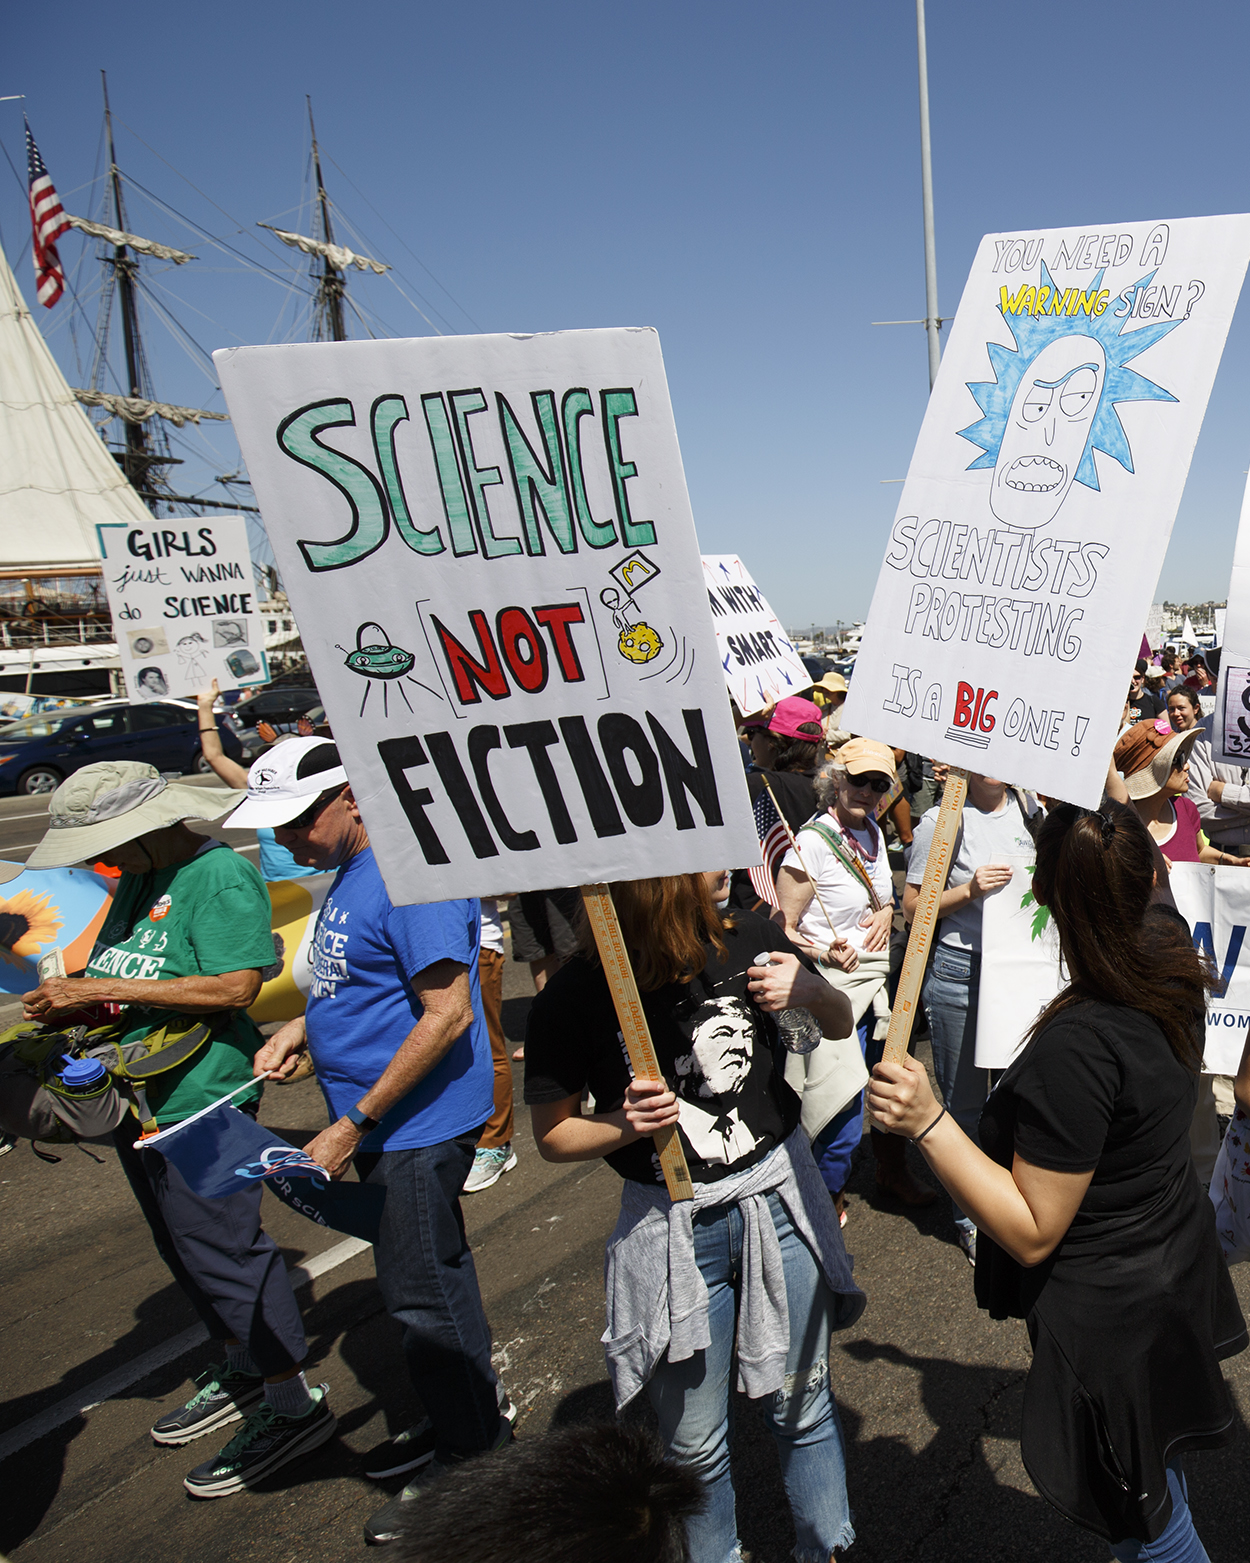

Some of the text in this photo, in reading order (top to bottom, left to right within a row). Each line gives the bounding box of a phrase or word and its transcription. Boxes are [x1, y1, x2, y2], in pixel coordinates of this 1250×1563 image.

[992, 224, 1170, 273] YOU NEED A
[999, 284, 1110, 316] WARNING
[276, 387, 658, 572] SCIENCE
[127, 528, 217, 561] GIRLS
[886, 516, 1110, 598] SCIENTISTS
[112, 562, 245, 593] just WANNA
[118, 593, 253, 620] do SCIENCE
[716, 586, 764, 614] WITH
[905, 583, 1084, 662] PROTESTING
[430, 602, 585, 705] NOT
[727, 630, 782, 666] SMART
[883, 664, 922, 718] IS
[921, 683, 943, 721] A
[953, 681, 999, 732] BIG
[1003, 698, 1065, 750] ONE
[377, 708, 724, 865] FICTION
[951, 779, 963, 810] HOME
[916, 839, 949, 954] THE HOME DEPOT
[607, 922, 616, 938] THE
[612, 940, 621, 952] OF
[616, 953, 628, 978] HOME
[628, 999, 657, 1081] THE HOME DEPOT
